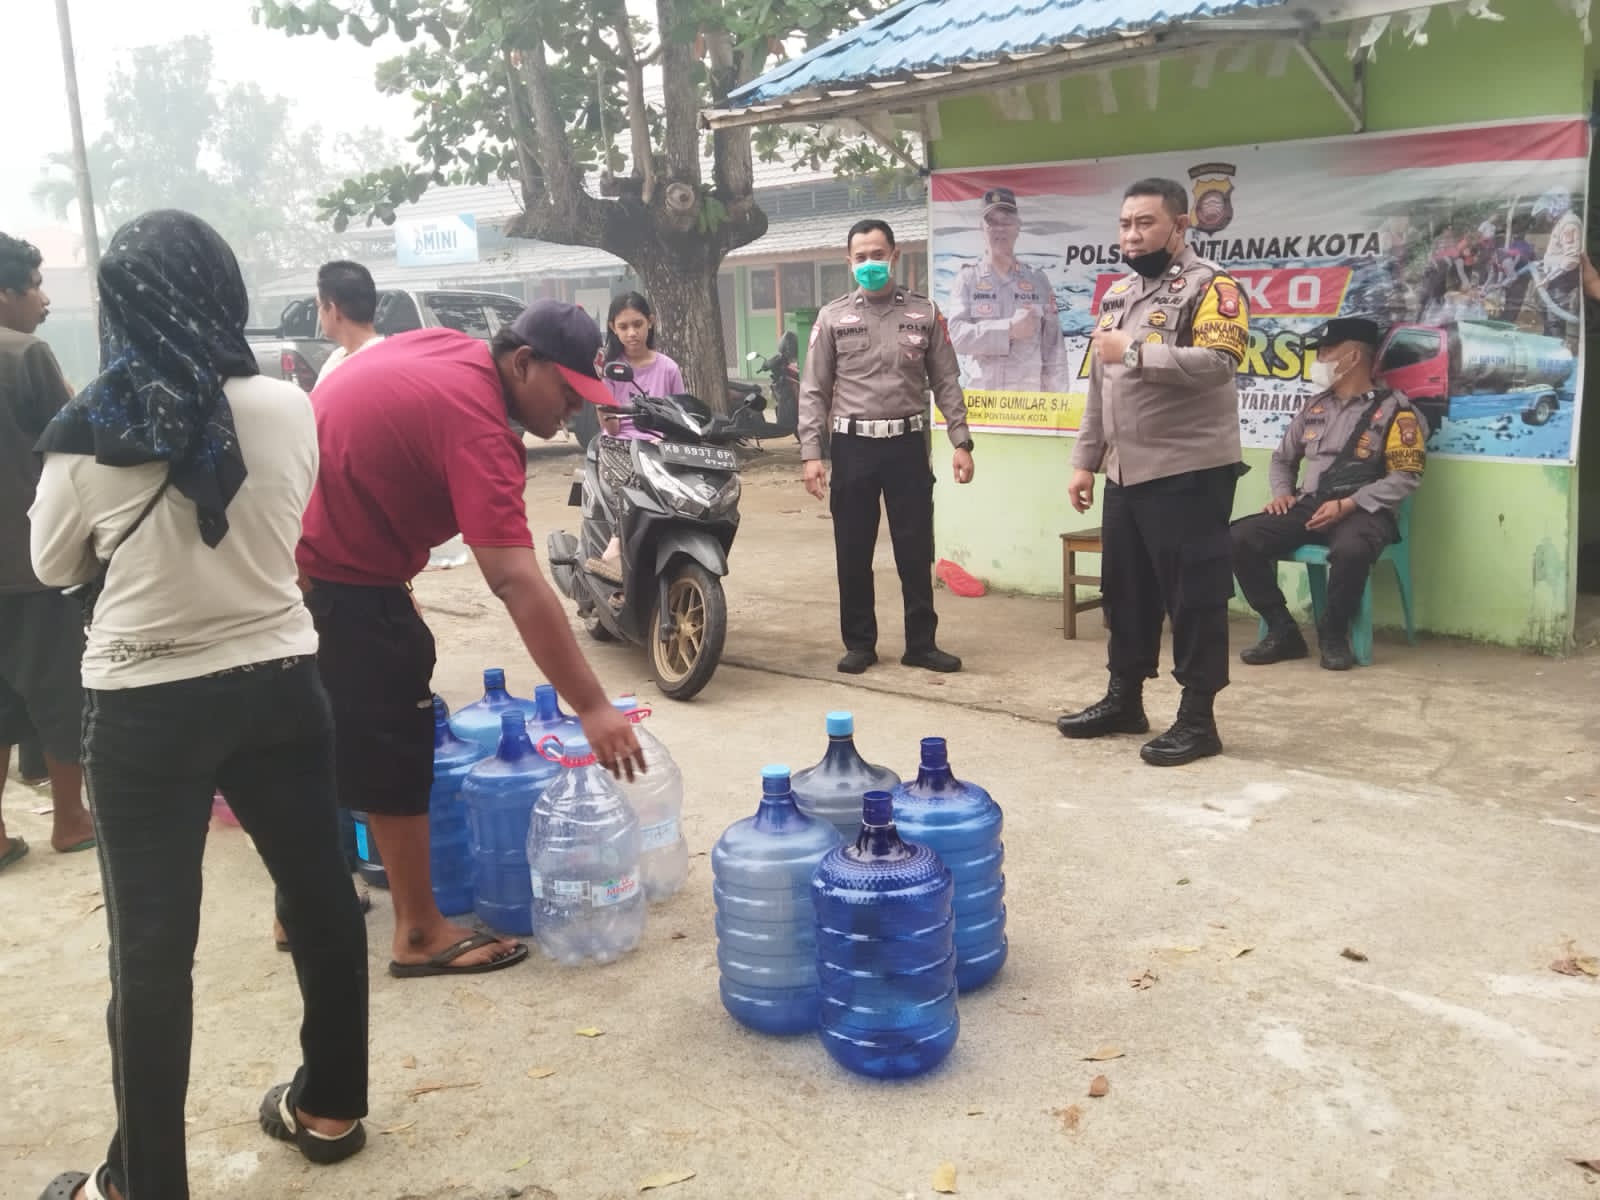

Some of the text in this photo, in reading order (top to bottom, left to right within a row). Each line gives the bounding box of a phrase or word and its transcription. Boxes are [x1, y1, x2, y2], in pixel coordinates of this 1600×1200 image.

[1066, 244, 1125, 265] POLS
[1306, 232, 1380, 257] KOTA
[967, 395, 997, 408] DENNI
[1027, 413, 1048, 422] KOTA
